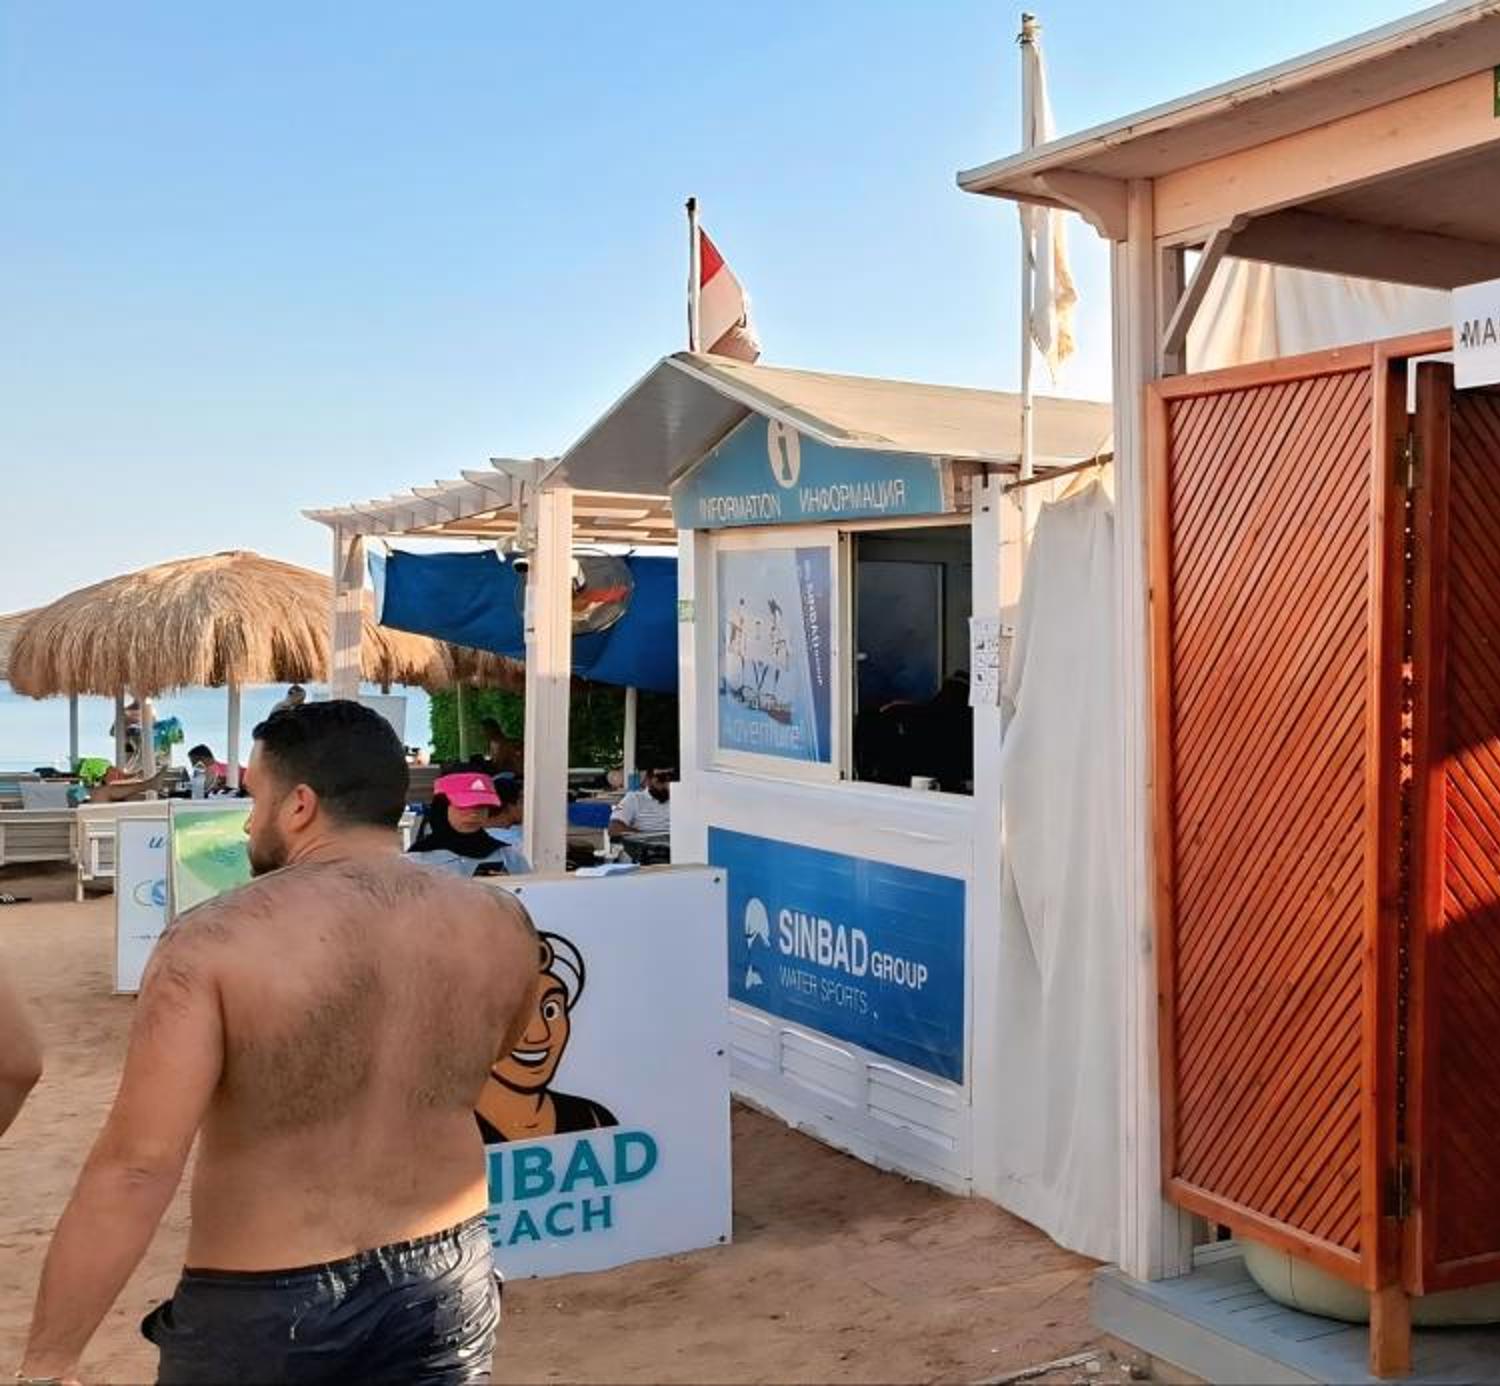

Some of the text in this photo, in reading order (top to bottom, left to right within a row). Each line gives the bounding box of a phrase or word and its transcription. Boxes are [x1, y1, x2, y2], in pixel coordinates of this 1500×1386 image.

[701, 493, 781, 521] INFORMATION
[799, 479, 906, 513] ИНФОРМАЦИЯ
[778, 908, 928, 990] SINBAD GROUP
[781, 965, 869, 1015] WATER SPORTS
